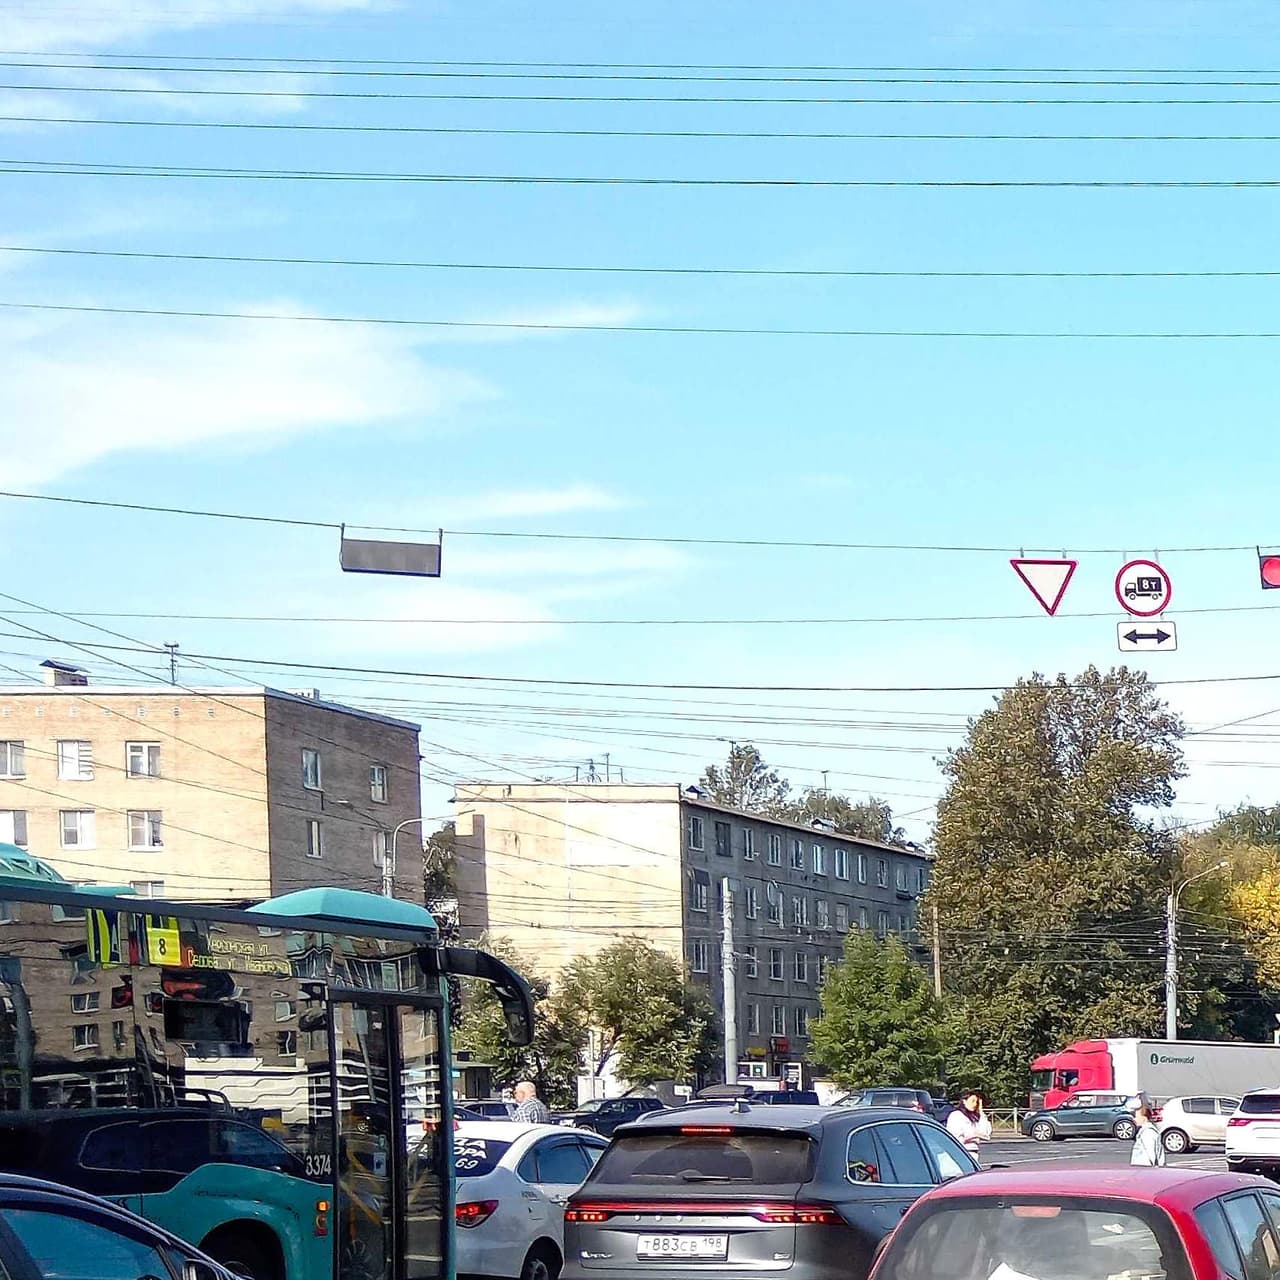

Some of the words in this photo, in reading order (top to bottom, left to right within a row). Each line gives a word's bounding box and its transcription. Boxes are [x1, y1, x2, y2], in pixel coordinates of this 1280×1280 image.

[157, 938, 167, 956] 8
[305, 1154, 332, 1176] 3374
[702, 1237, 722, 1248] 198
